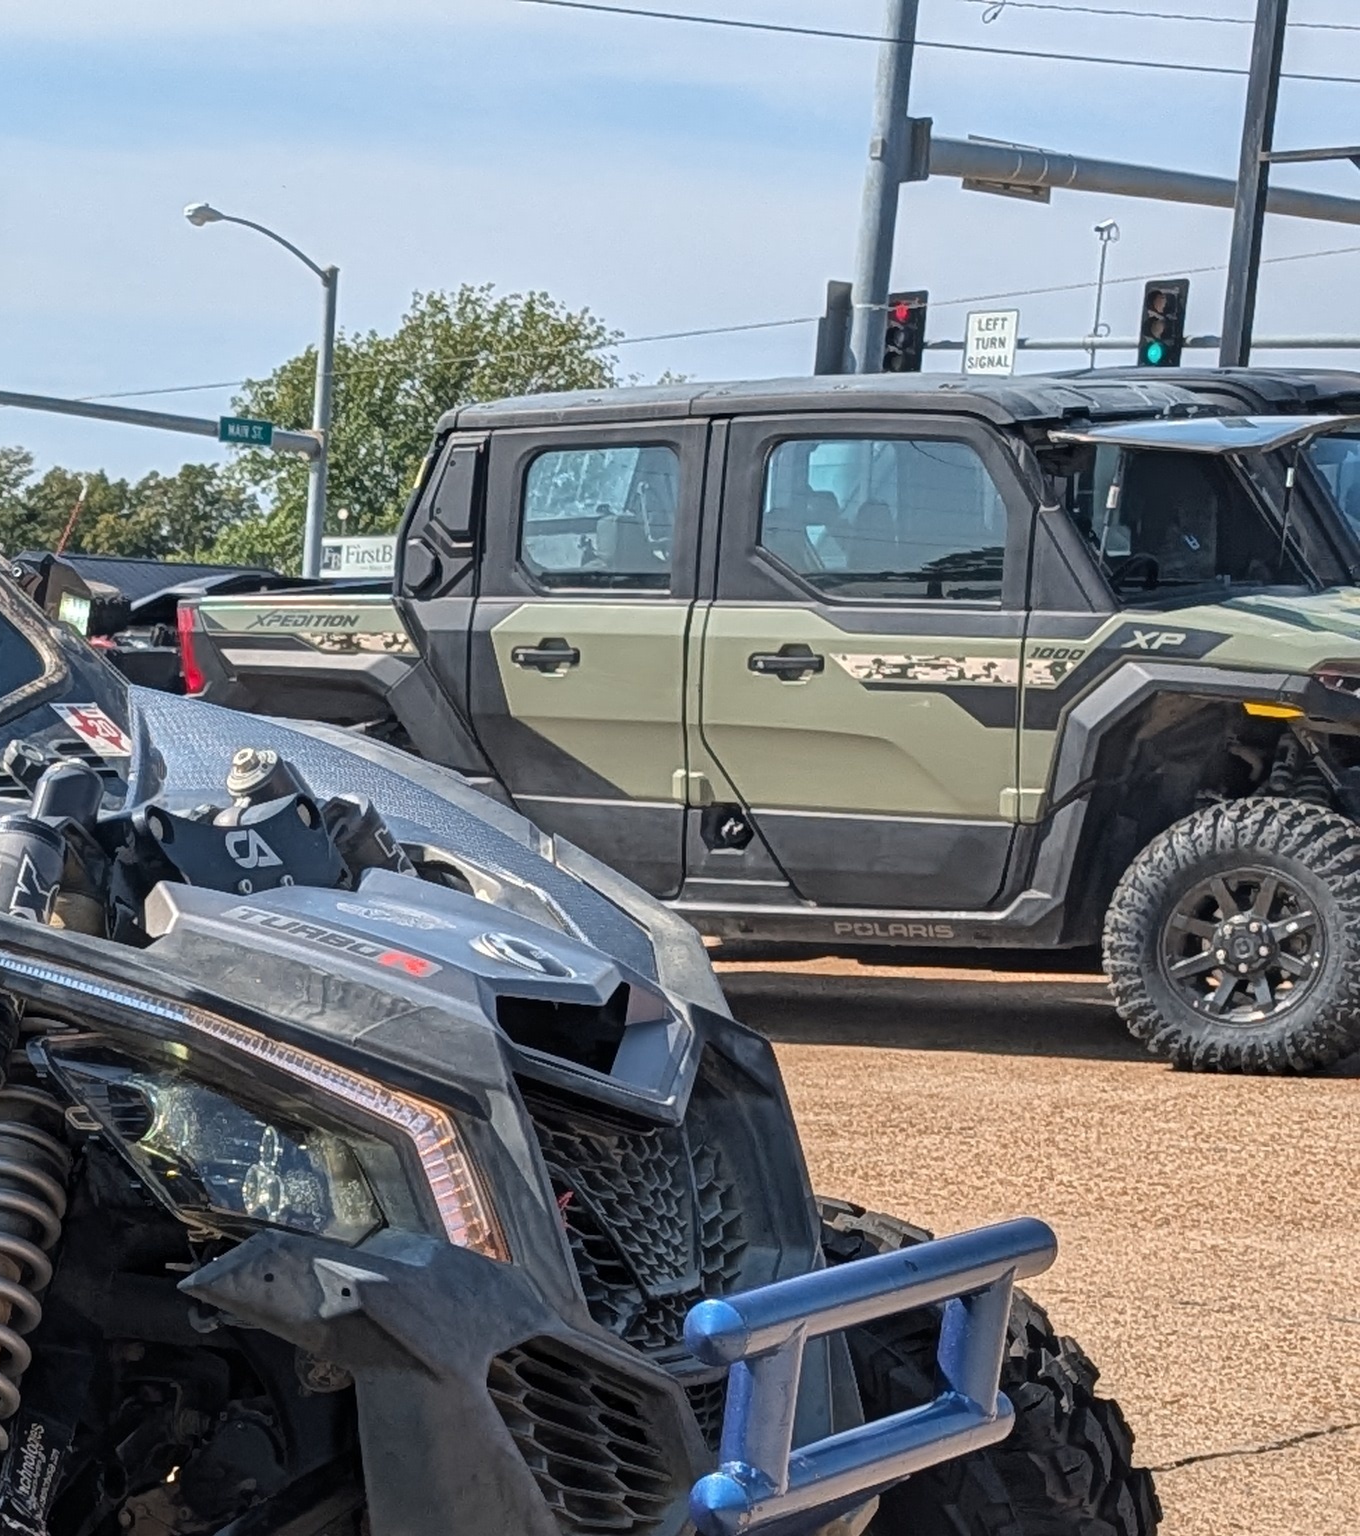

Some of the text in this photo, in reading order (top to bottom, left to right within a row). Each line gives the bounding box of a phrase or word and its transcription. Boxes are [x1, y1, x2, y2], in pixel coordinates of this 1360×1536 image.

[977, 316, 1008, 332] LEFT
[974, 336, 1007, 350] TURN
[967, 355, 1010, 369] SIGNAL
[227, 424, 249, 439] MAIN
[344, 543, 393, 565] FirstB
[246, 609, 361, 630] XPEDITION
[1120, 629, 1187, 650] XP
[1030, 646, 1086, 660] 1000
[86, 718, 119, 738] 20
[238, 907, 380, 960] TURBO
[833, 921, 955, 939] POLARIS
